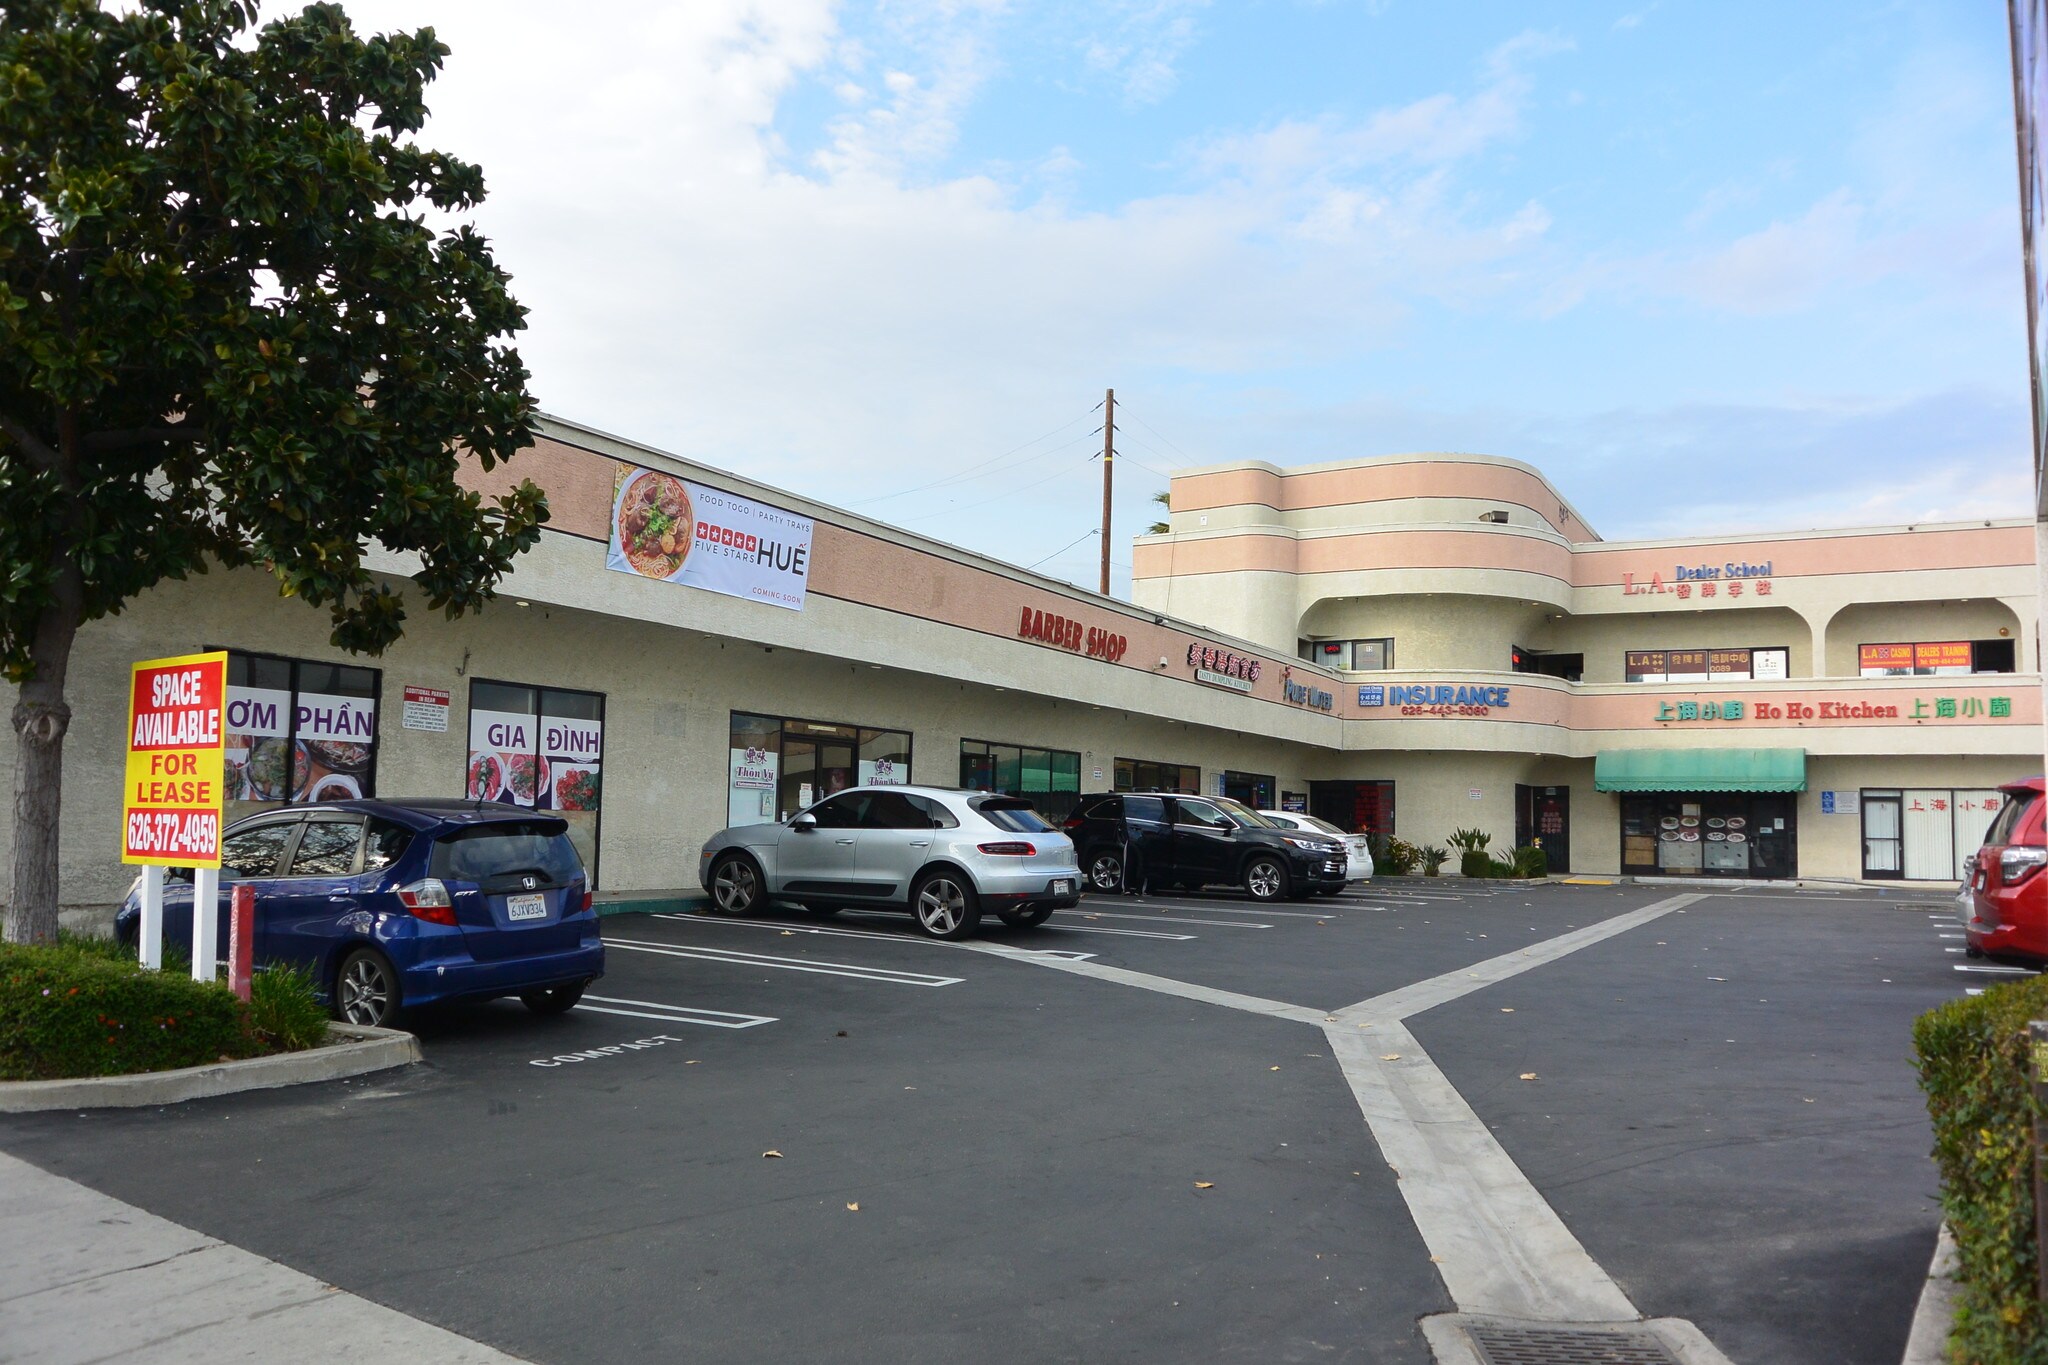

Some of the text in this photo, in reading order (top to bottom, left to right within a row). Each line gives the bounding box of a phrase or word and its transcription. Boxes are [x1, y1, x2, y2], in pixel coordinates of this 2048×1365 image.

[699, 493, 810, 533] FOOD TOGO PARTY TRAYS
[695, 540, 755, 563] FIVE STARS
[1623, 561, 1773, 595] L.A. Dealer School
[752, 587, 801, 604] COMING SOON
[1018, 606, 1127, 662] BARBER SHOP
[1890, 648, 1911, 658] CASINO
[1917, 646, 1940, 657] DEALERS
[1942, 645, 1968, 657] TRAINING
[152, 671, 201, 708] SPACE
[431, 690, 449, 698] PARKING
[1389, 685, 1510, 707] INSURANCE
[226, 699, 372, 737] ƠM PHẦN
[1754, 701, 1898, 719] Ho Ho Kitchen
[133, 708, 218, 746] AVAILABLE
[487, 723, 599, 753] GIA ĐÌNH
[151, 753, 197, 776] FOR
[137, 781, 210, 803] LEASE
[128, 812, 217, 854] 626-372-4959
[511, 902, 544, 917] 6JXV334
[529, 1034, 683, 1068] COMPACT
